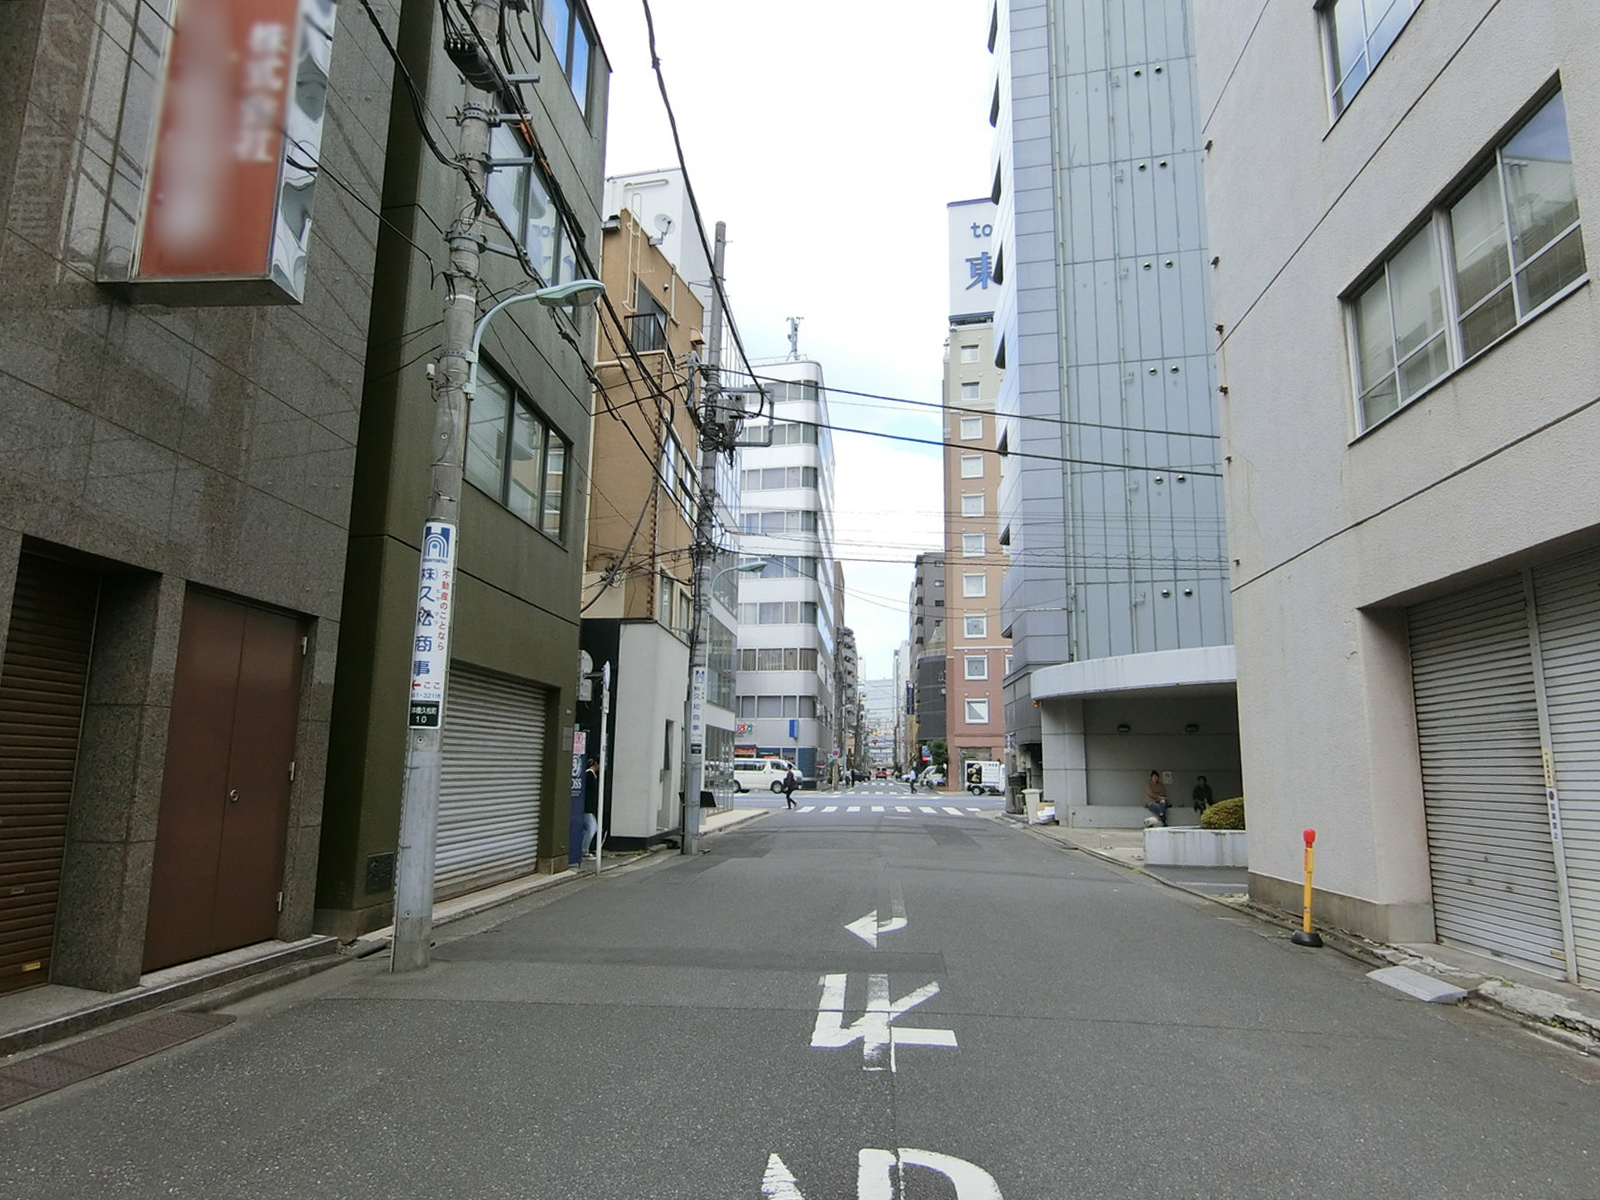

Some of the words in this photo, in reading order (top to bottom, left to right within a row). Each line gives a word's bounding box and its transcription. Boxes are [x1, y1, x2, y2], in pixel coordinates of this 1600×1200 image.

[965, 251, 993, 290] 東
[437, 571, 451, 651] 不動産のことなら
[415, 715, 428, 724] 10
